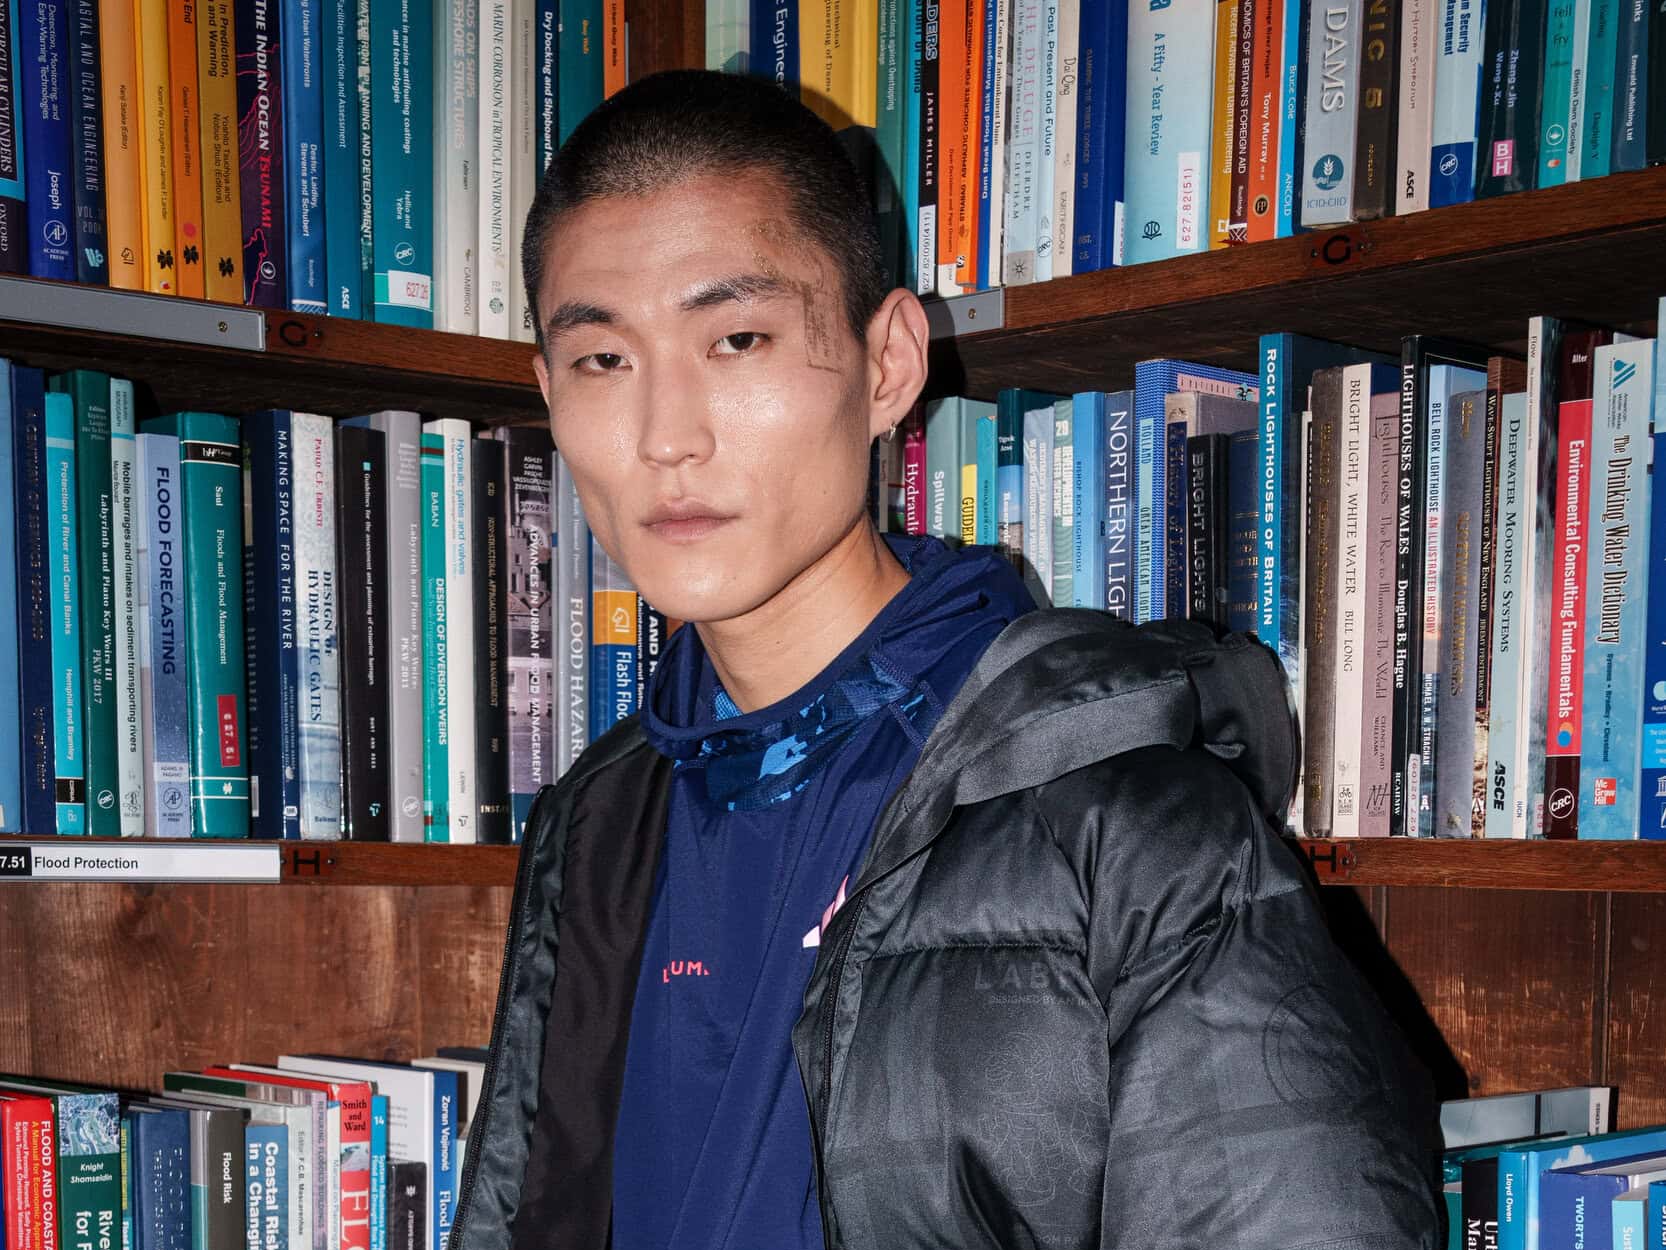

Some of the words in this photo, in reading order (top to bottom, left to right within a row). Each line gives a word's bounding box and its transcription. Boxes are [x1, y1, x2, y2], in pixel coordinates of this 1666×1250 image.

[255, 1, 267, 30] THE
[493, 3, 504, 44] MARINE
[81, 43, 95, 64] AND
[256, 34, 269, 92] INDIAN
[1151, 44, 1165, 72] Fifty
[1241, 41, 1251, 55] OF
[1321, 8, 1349, 113] DAMS
[82, 71, 96, 110] OCEAN
[493, 45, 504, 106] CORROSION
[1240, 57, 1250, 106] BRITAIN'S
[493, 109, 503, 118] in
[926, 92, 934, 132] JAMES
[1151, 85, 1163, 110] Year
[1261, 93, 1271, 119] Tony
[257, 93, 270, 152] OCEAN
[492, 119, 503, 167] TROPICAL
[1150, 114, 1162, 156] Review
[1238, 108, 1248, 154] FOREIGN
[1260, 122, 1271, 163] Murray
[83, 115, 98, 191] ENGINEERING
[926, 138, 934, 186] MILLER
[1238, 156, 1247, 174] AID
[48, 171, 61, 209] Joseph
[258, 156, 272, 228] TSUNAMI
[1283, 173, 1292, 216] ANCOLD
[1406, 171, 1415, 199] ASCE
[492, 170, 503, 252] ENVIRONMENTS
[341, 286, 349, 309] ASCE
[1266, 348, 1277, 396] ROCK
[1349, 379, 1362, 432] BRIGHT
[1400, 364, 1414, 471] LIGHTHOUSES
[277, 430, 289, 485] MAKING
[1264, 402, 1276, 523] LIGHTHOUSES
[1347, 440, 1360, 486] LIGHT,
[1504, 419, 1521, 504] DEEPWATER
[1613, 436, 1630, 453] The
[156, 467, 172, 533] FLOOD
[214, 486, 224, 507] Saul
[933, 471, 945, 531] Spillway
[1109, 411, 1128, 553] NORTHERN
[1400, 477, 1412, 498] OF
[1564, 439, 1585, 540] Environmental
[1603, 457, 1632, 521] Drinking
[278, 491, 290, 533] SPACE
[430, 491, 439, 527] BABAN
[1346, 493, 1359, 538] WHITE
[1399, 504, 1412, 555] WALES
[215, 529, 227, 558] Floods
[279, 544, 291, 570] FOR
[1264, 528, 1275, 550] OF
[1501, 512, 1518, 583] MOORING
[1601, 524, 1630, 566] Water
[216, 561, 227, 577] and
[280, 577, 292, 602] THE
[1263, 556, 1275, 625] BRITAIN
[1345, 545, 1358, 595] WATER
[1561, 544, 1581, 618] Consulting
[158, 541, 175, 675] FORECASTING
[216, 580, 228, 606] Flood
[435, 578, 446, 621] DESIGN
[1395, 579, 1408, 629] Douglas
[1598, 571, 1629, 645] Dictionary
[217, 609, 229, 665] Management
[281, 609, 293, 650] RIVER
[308, 570, 321, 664] HYDRAULIC
[436, 624, 446, 640] OF
[570, 597, 584, 669] FLOOD
[1344, 610, 1356, 633] BILL
[1394, 632, 1407, 645] B.
[1499, 590, 1515, 653] SYSTEMS
[92, 649, 102, 674] PKW
[436, 642, 447, 705] DIVERSION
[615, 651, 632, 686] Flash
[1343, 640, 1355, 672] LONG
[1394, 649, 1407, 689] Hague
[1558, 621, 1578, 718] Fundamentals
[92, 678, 103, 704] 2017
[309, 671, 322, 722] GATES
[437, 708, 447, 745] WEIRS
[1493, 761, 1507, 810] ASCE
[41, 1121, 52, 1166] FLOOD
[248, 1143, 261, 1159] in
[42, 1168, 53, 1198] AND
[223, 1152, 233, 1180] Flood
[248, 1165, 261, 1176] a
[264, 1142, 278, 1209] Coastal
[223, 1182, 233, 1204] Risk
[76, 1210, 92, 1235] for
[1574, 1196, 1583, 1250] TWORT'S
